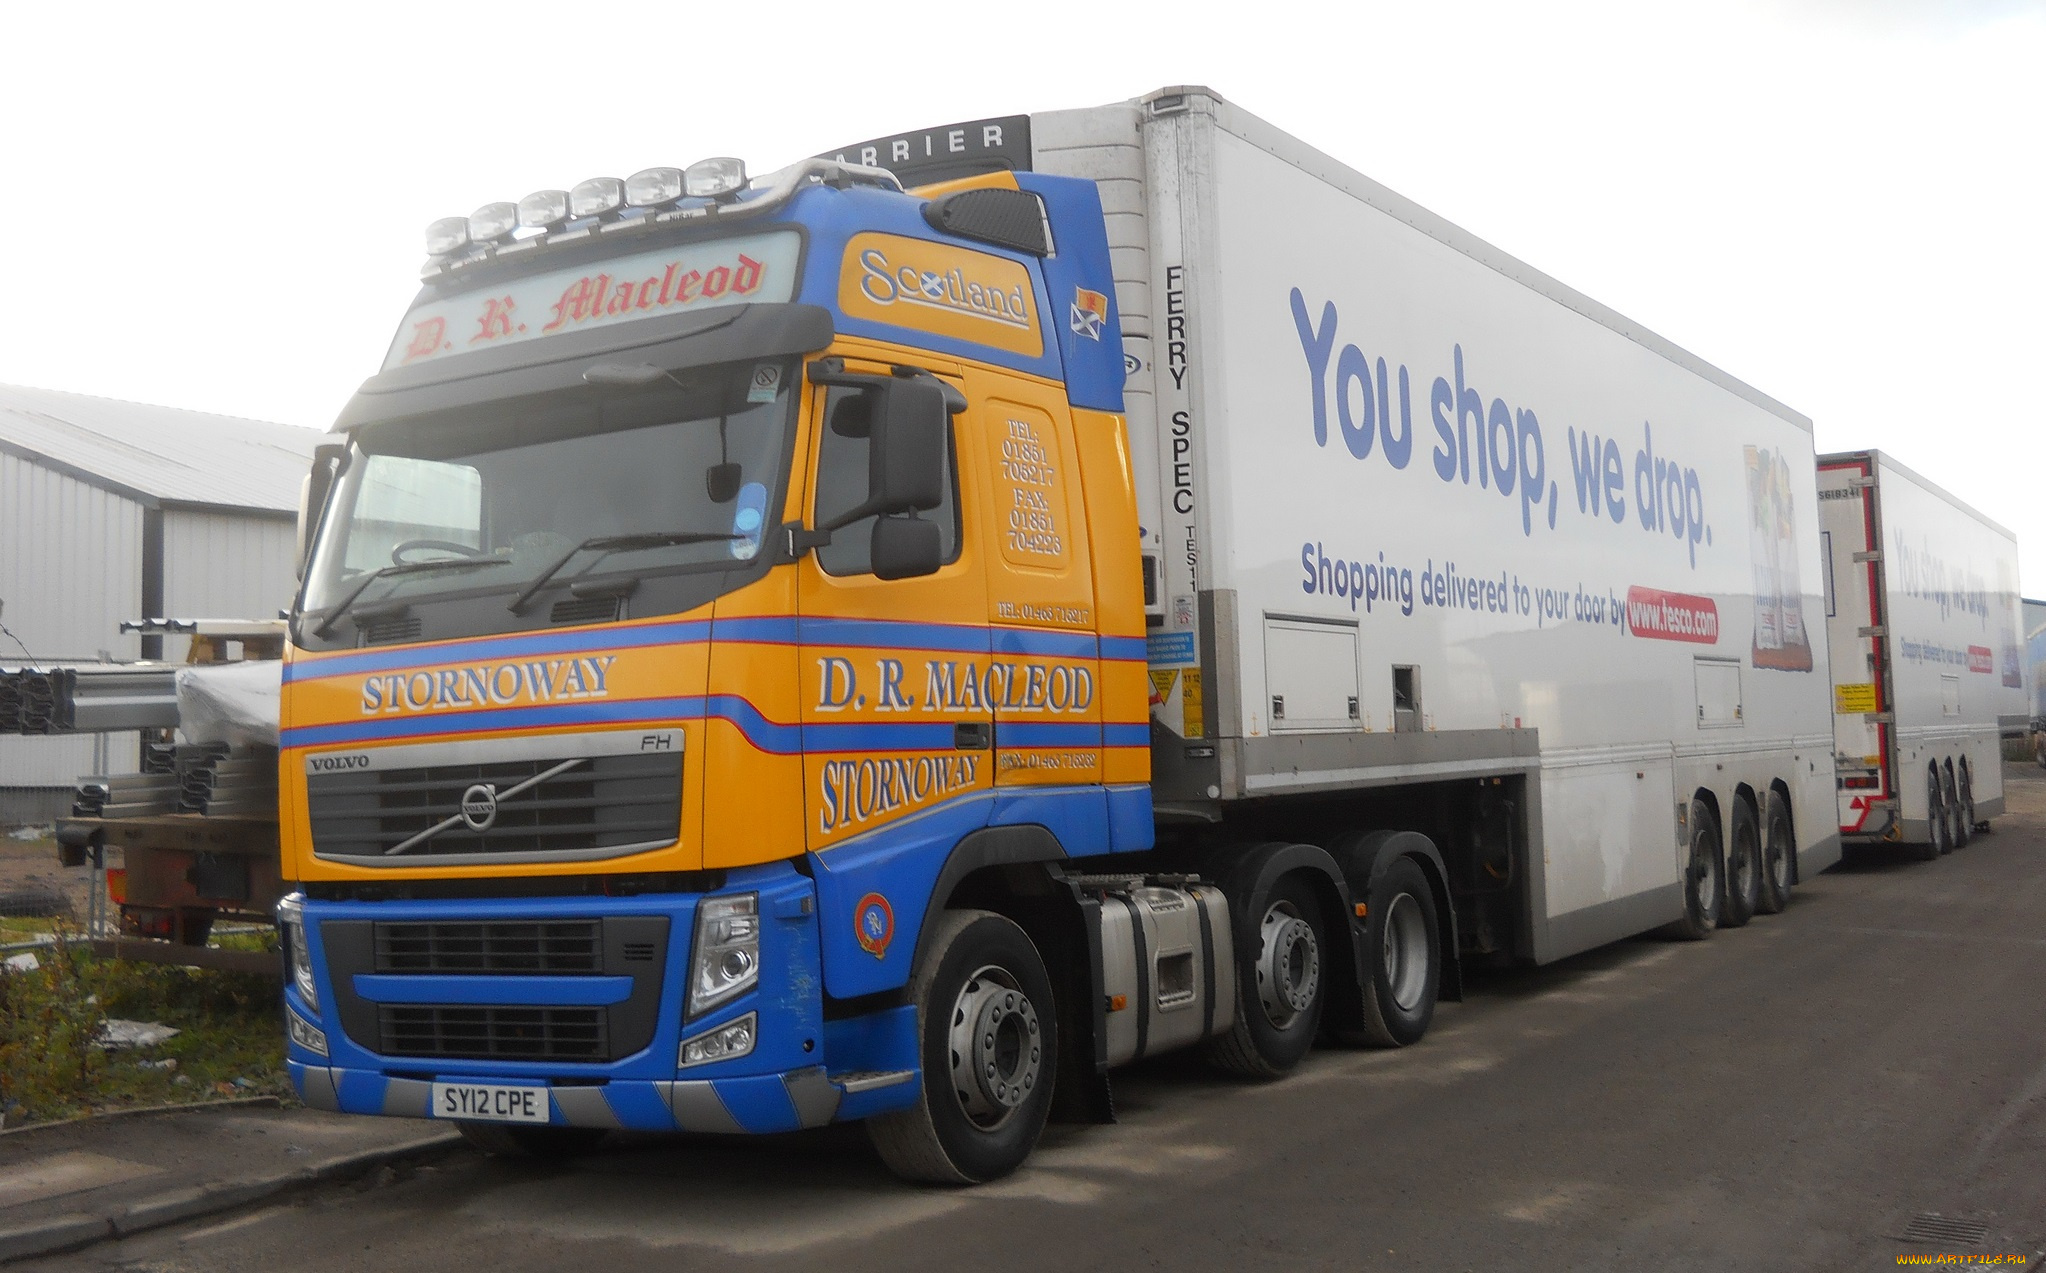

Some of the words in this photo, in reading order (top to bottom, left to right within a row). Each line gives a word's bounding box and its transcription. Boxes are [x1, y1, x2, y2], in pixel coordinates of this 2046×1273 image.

[401, 316, 452, 366] D.
[470, 295, 527, 344] R.
[542, 253, 767, 338] Macleod
[1166, 265, 1187, 390] FERRY
[1007, 419, 1039, 443] TEL:
[1290, 286, 1412, 470] You
[1430, 343, 1558, 537] shop,
[1568, 425, 1626, 524] we
[1634, 420, 1712, 571] drop.
[1171, 411, 1194, 514] SPEC
[998, 602, 1020, 618] TEL:
[1302, 541, 1413, 617] Shopping
[1421, 558, 1508, 614] delivered
[1513, 575, 1530, 616] to
[1535, 587, 1569, 629] your
[1574, 582, 1605, 624] door
[1609, 587, 1625, 636] by
[1629, 597, 1716, 637] www.tesco.com
[361, 655, 617, 715] STORNOWAY
[815, 657, 866, 713] D.
[874, 658, 915, 713] R.
[921, 659, 1093, 714] MACLEOD
[310, 755, 370, 771] VOLVO
[641, 734, 672, 751] FH
[820, 755, 981, 835] STORNOWAY
[446, 1088, 489, 1114] SY12
[495, 1090, 535, 1116] CPE
